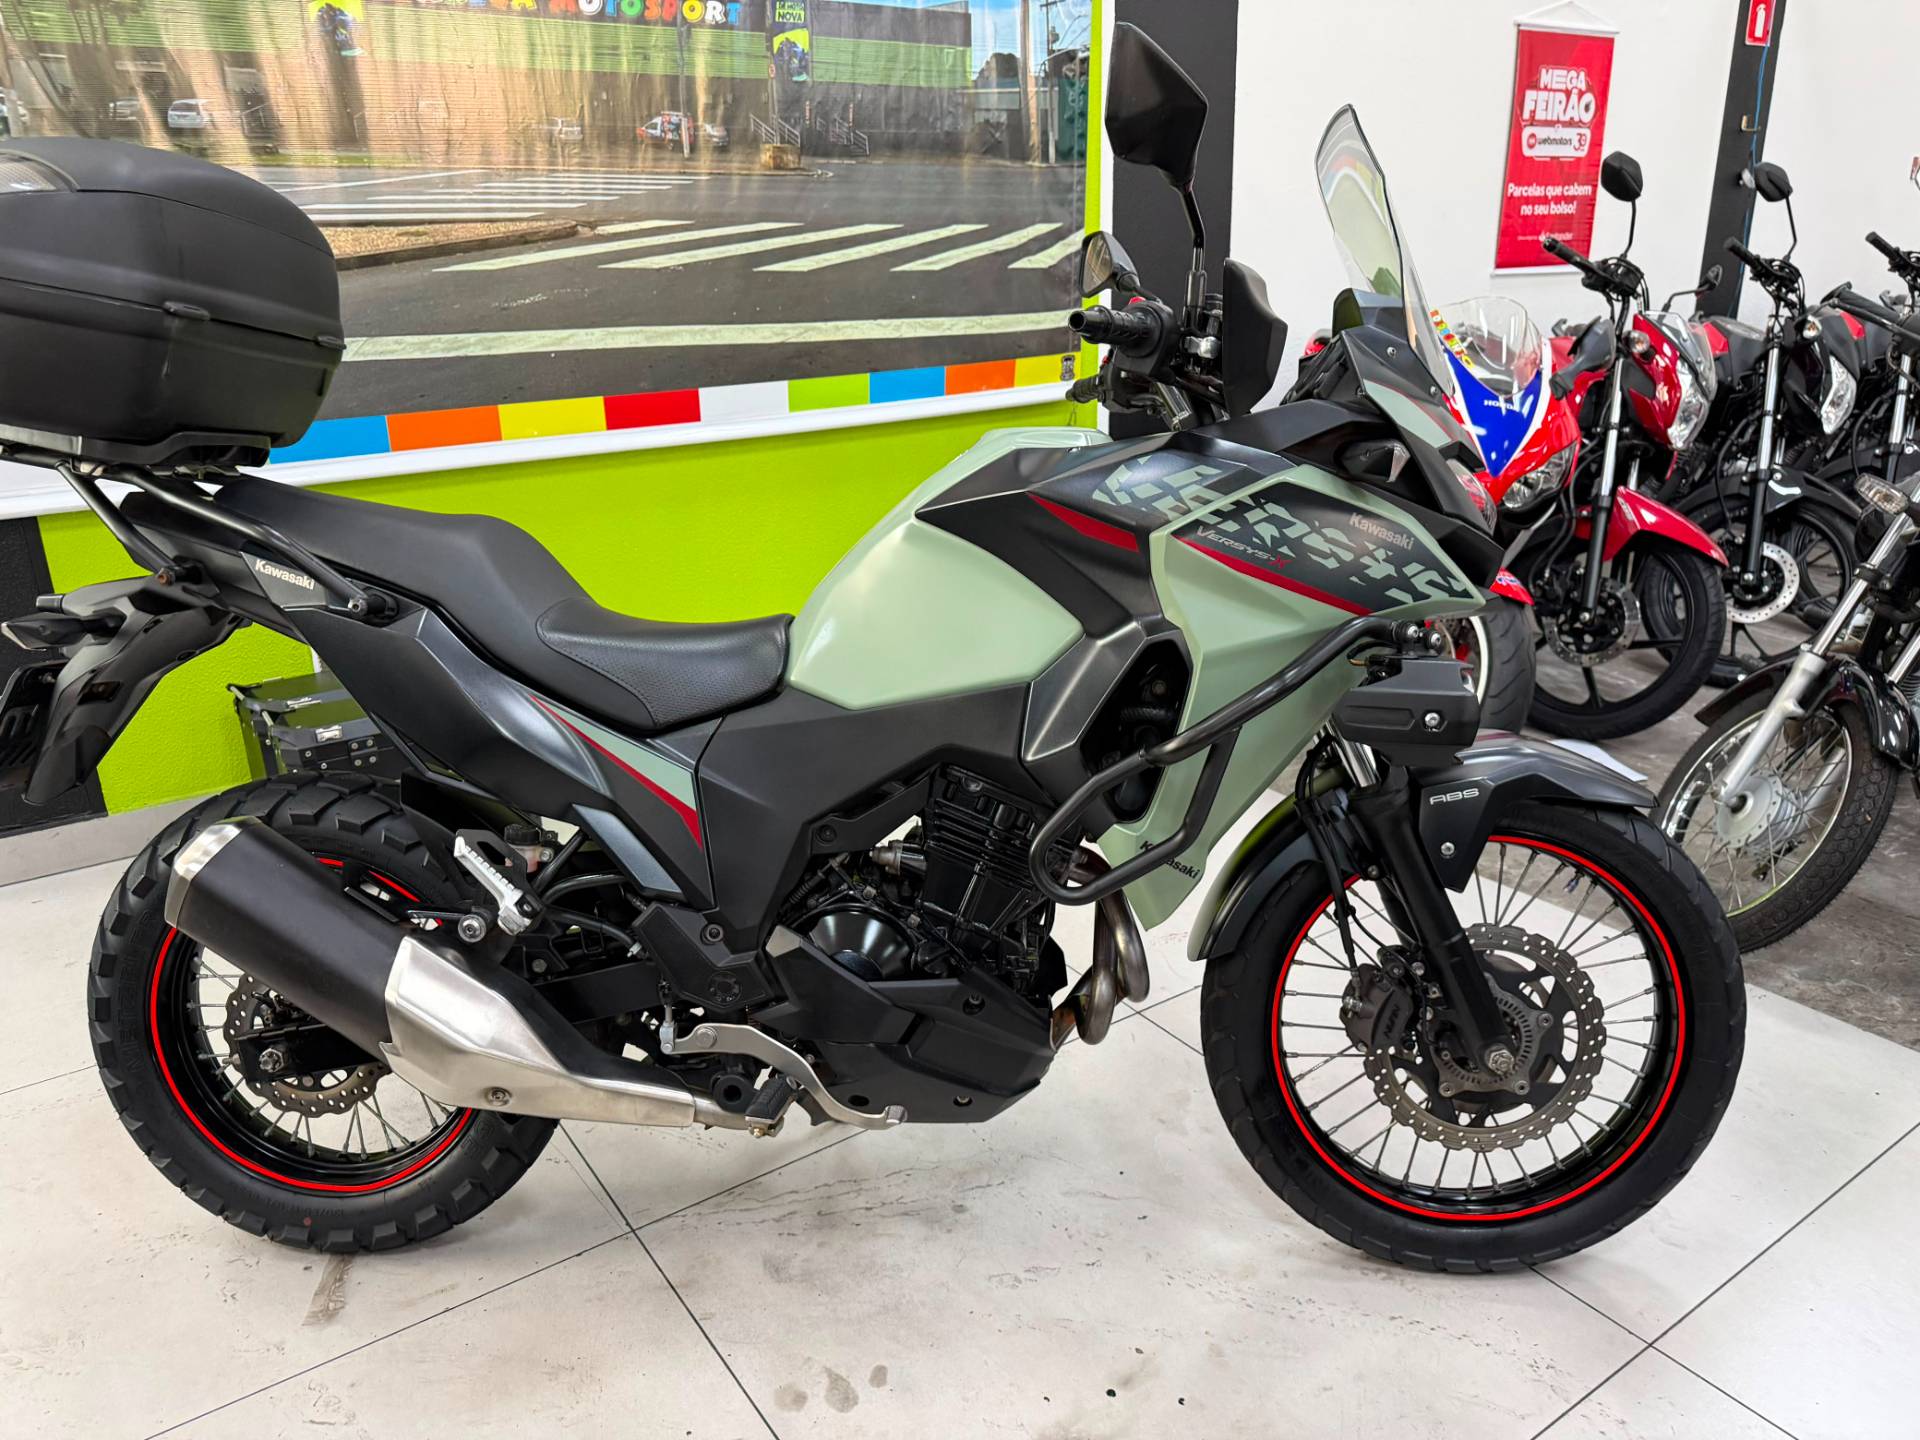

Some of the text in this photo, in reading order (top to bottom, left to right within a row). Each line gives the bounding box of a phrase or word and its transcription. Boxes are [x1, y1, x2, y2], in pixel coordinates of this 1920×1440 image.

[777, 11, 803, 22] NOVA
[1540, 68, 1587, 91] MEGA
[1522, 87, 1596, 123] FEIRÃO
[1507, 182, 1592, 200] Parcelas que cabem
[1520, 200, 1578, 216] no seu bolso!
[1483, 399, 1519, 412] HOD
[1350, 512, 1414, 550] Kawasaki
[255, 558, 316, 591] Kawasaki
[1429, 787, 1480, 806] ABS
[1139, 840, 1201, 880] Kasaki
